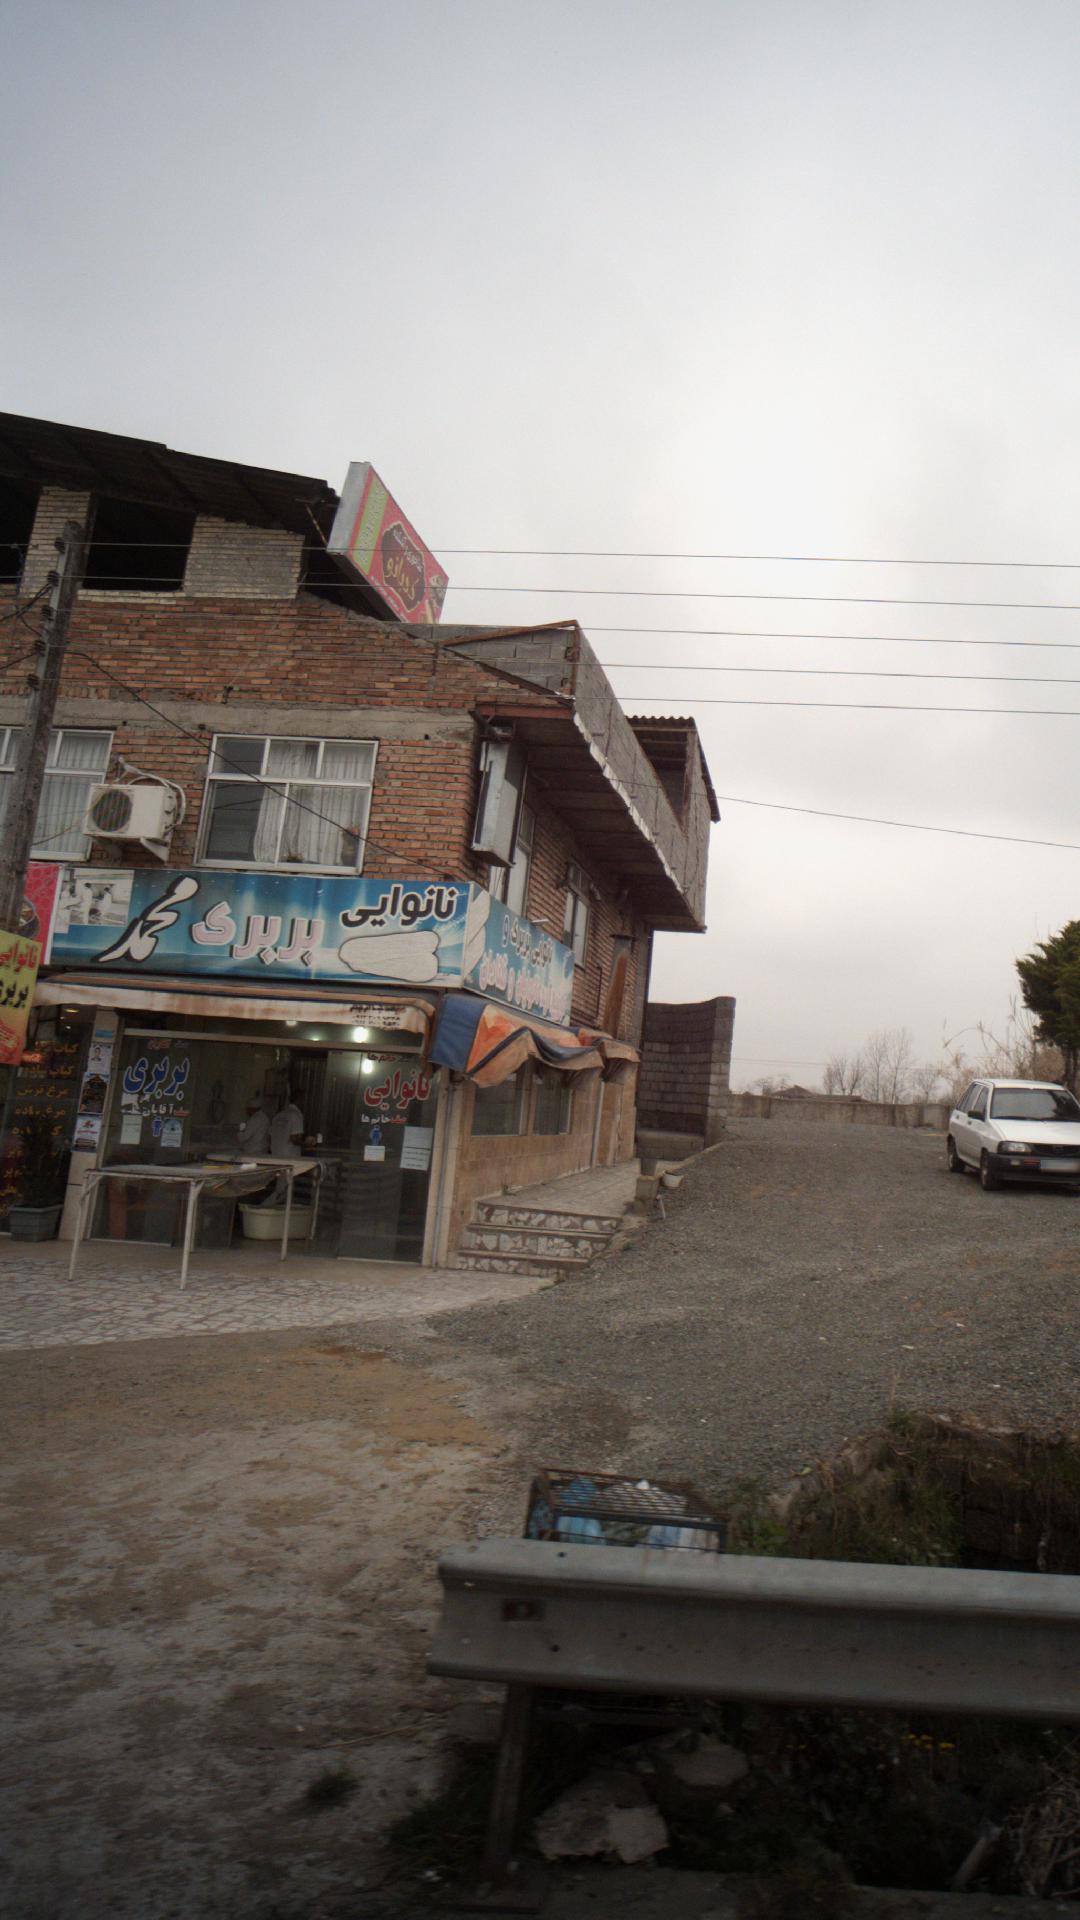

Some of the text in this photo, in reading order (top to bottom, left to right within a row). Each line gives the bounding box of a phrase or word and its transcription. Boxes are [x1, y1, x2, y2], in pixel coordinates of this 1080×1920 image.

[340, 884, 459, 928] نانوایی
[192, 901, 324, 966] بربری
[123, 1056, 191, 1100] بربری
[363, 1068, 432, 1111] نانوایی
